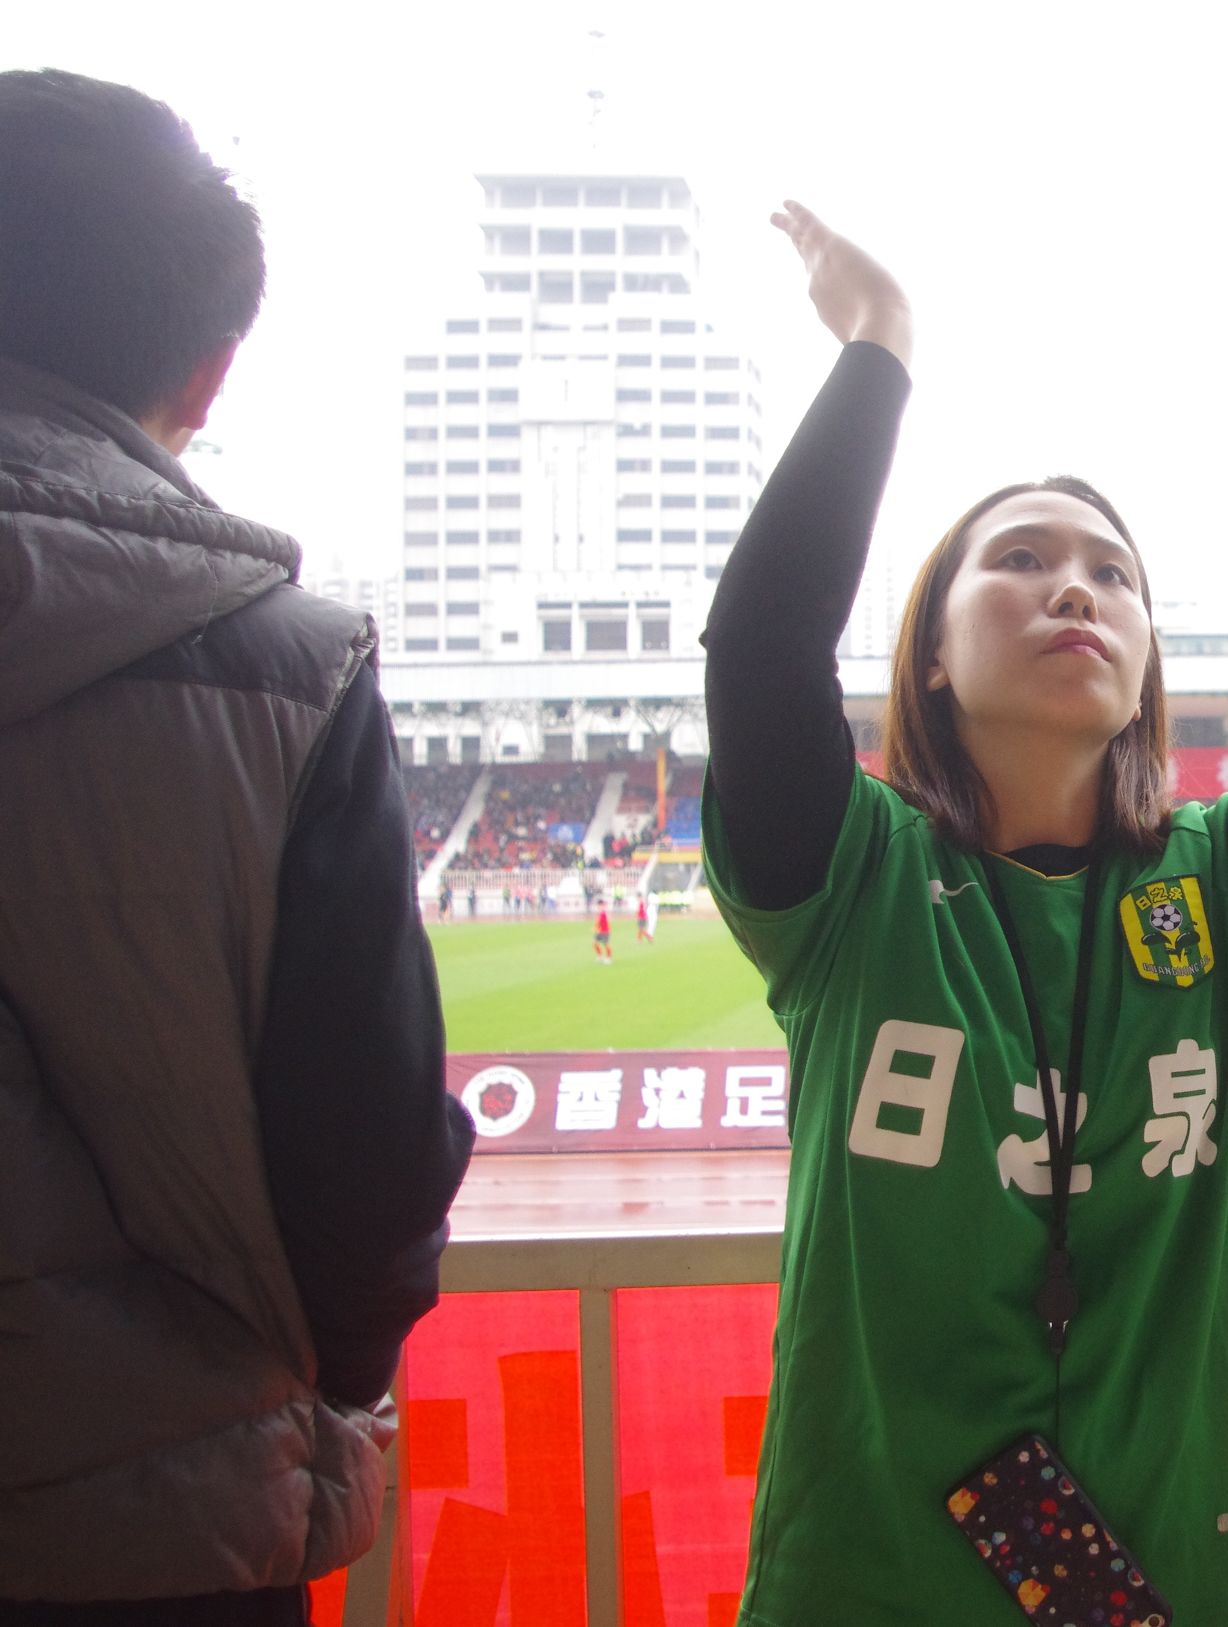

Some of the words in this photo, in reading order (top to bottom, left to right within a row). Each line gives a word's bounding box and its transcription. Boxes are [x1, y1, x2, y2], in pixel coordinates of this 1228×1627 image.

[554, 1065, 787, 1131] 香港足
[848, 1019, 1217, 1196] 日之泉
